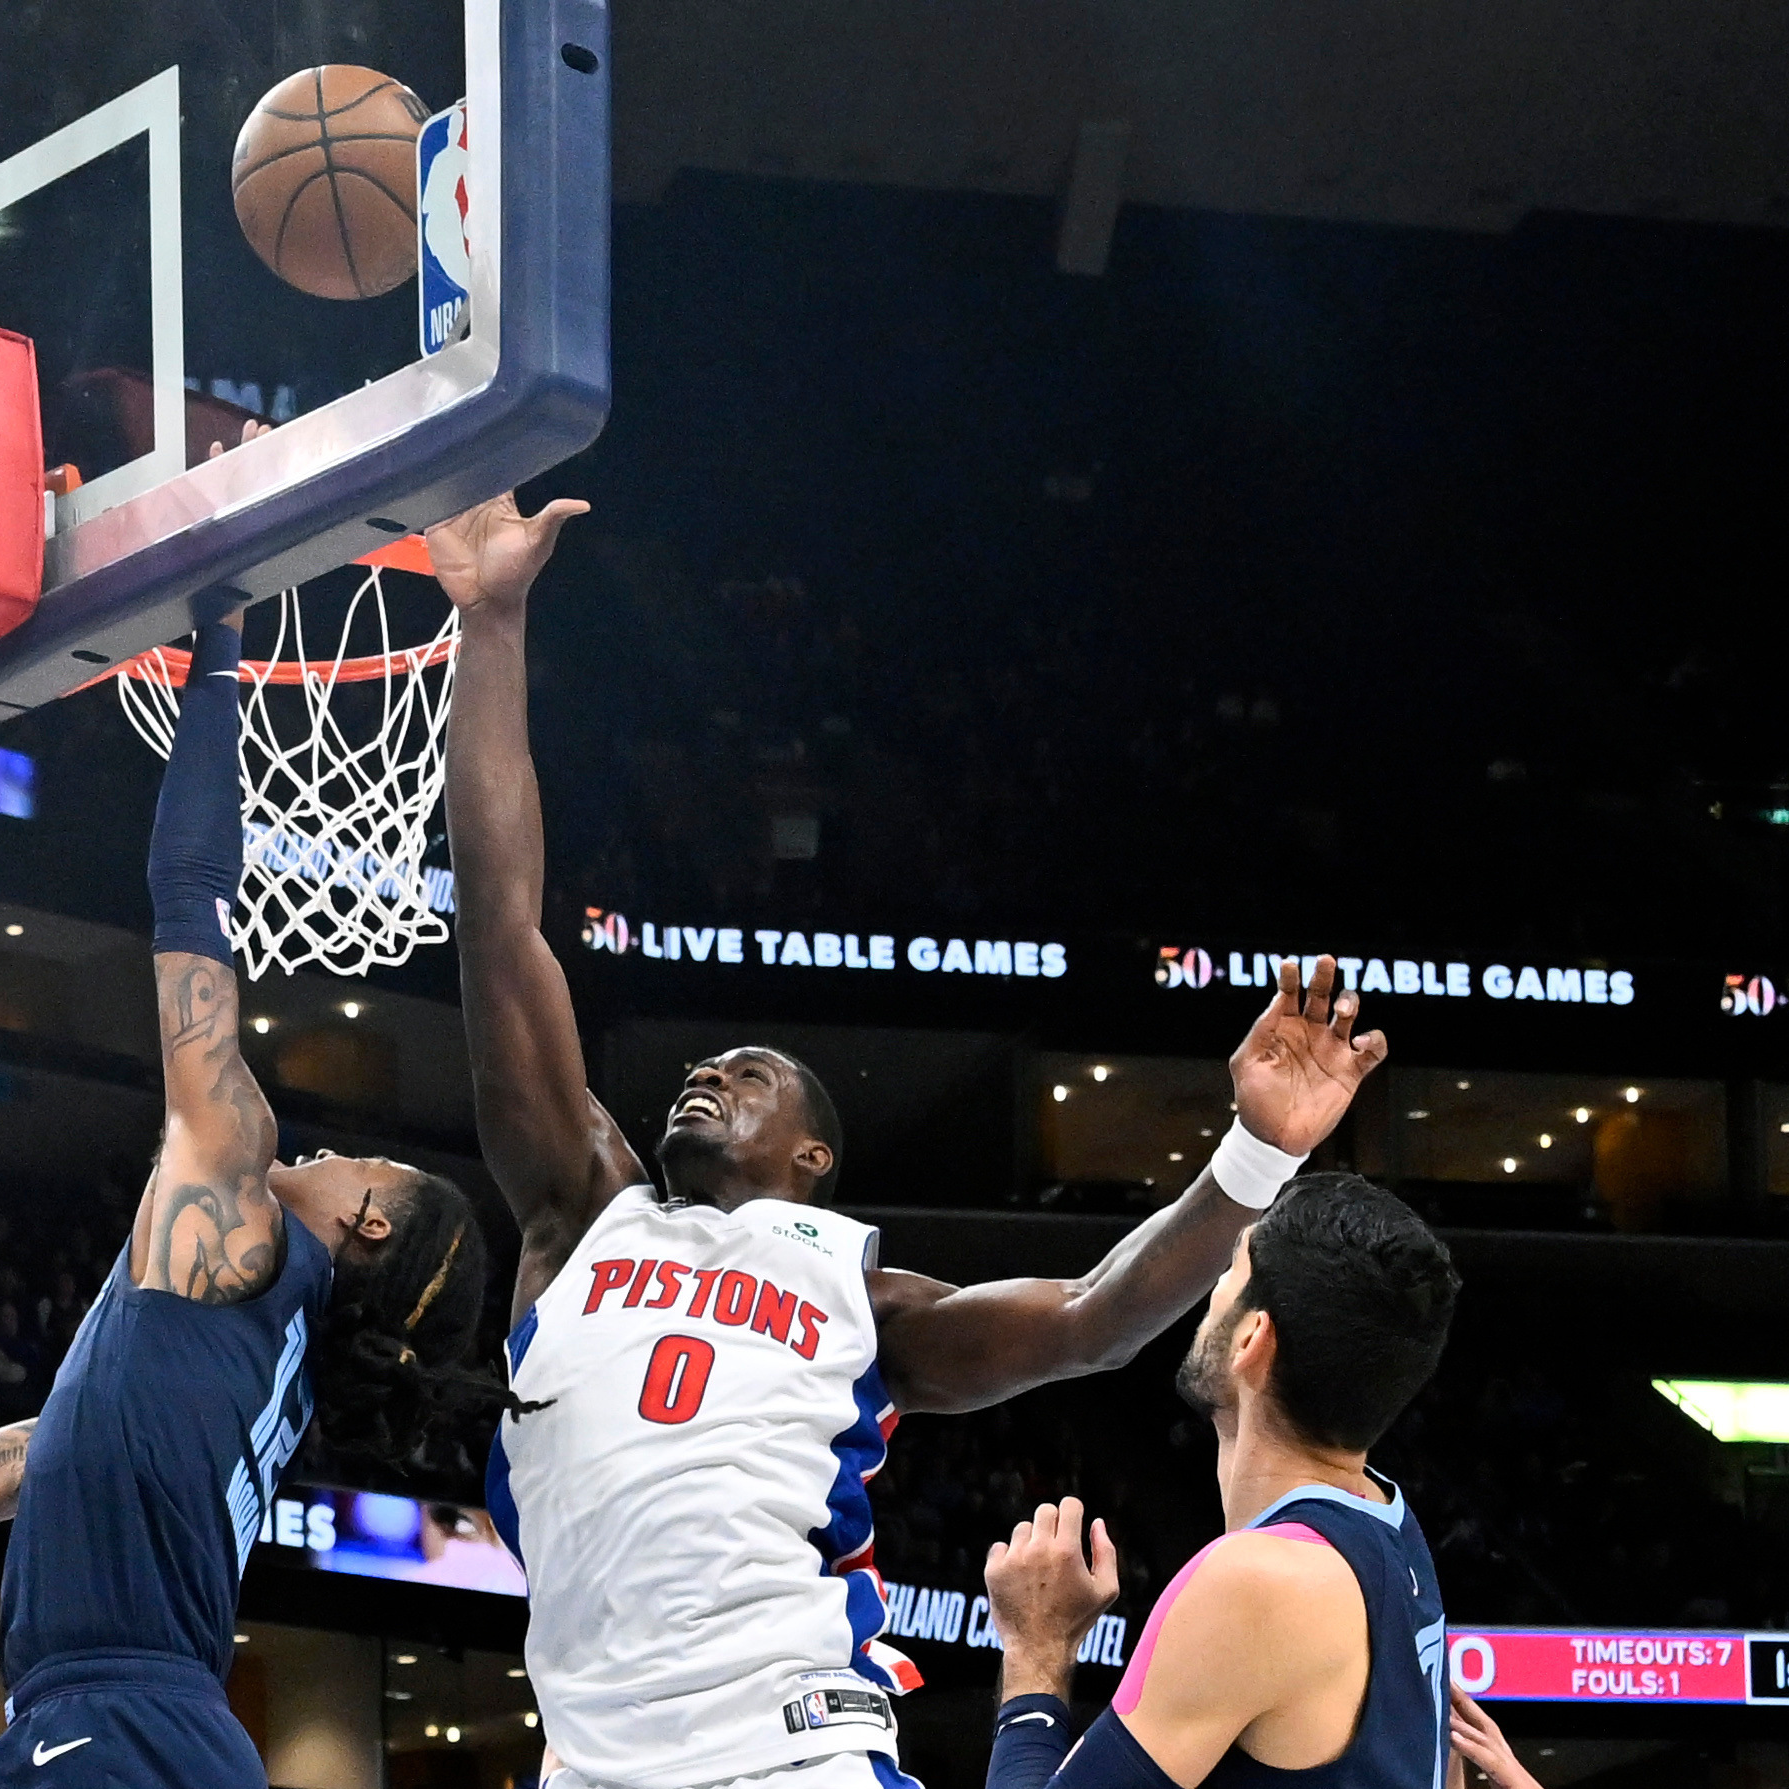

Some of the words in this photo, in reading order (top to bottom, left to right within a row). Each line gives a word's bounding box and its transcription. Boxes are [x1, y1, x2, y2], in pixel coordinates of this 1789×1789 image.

[642, 921, 744, 964] LIVE
[752, 929, 897, 971] TABLE
[907, 936, 1068, 978] GAMES
[1336, 956, 1470, 999] TABLE
[1481, 961, 1634, 1005] GAMES
[582, 1258, 830, 1362] PISTONS
[637, 1333, 716, 1425] 0
